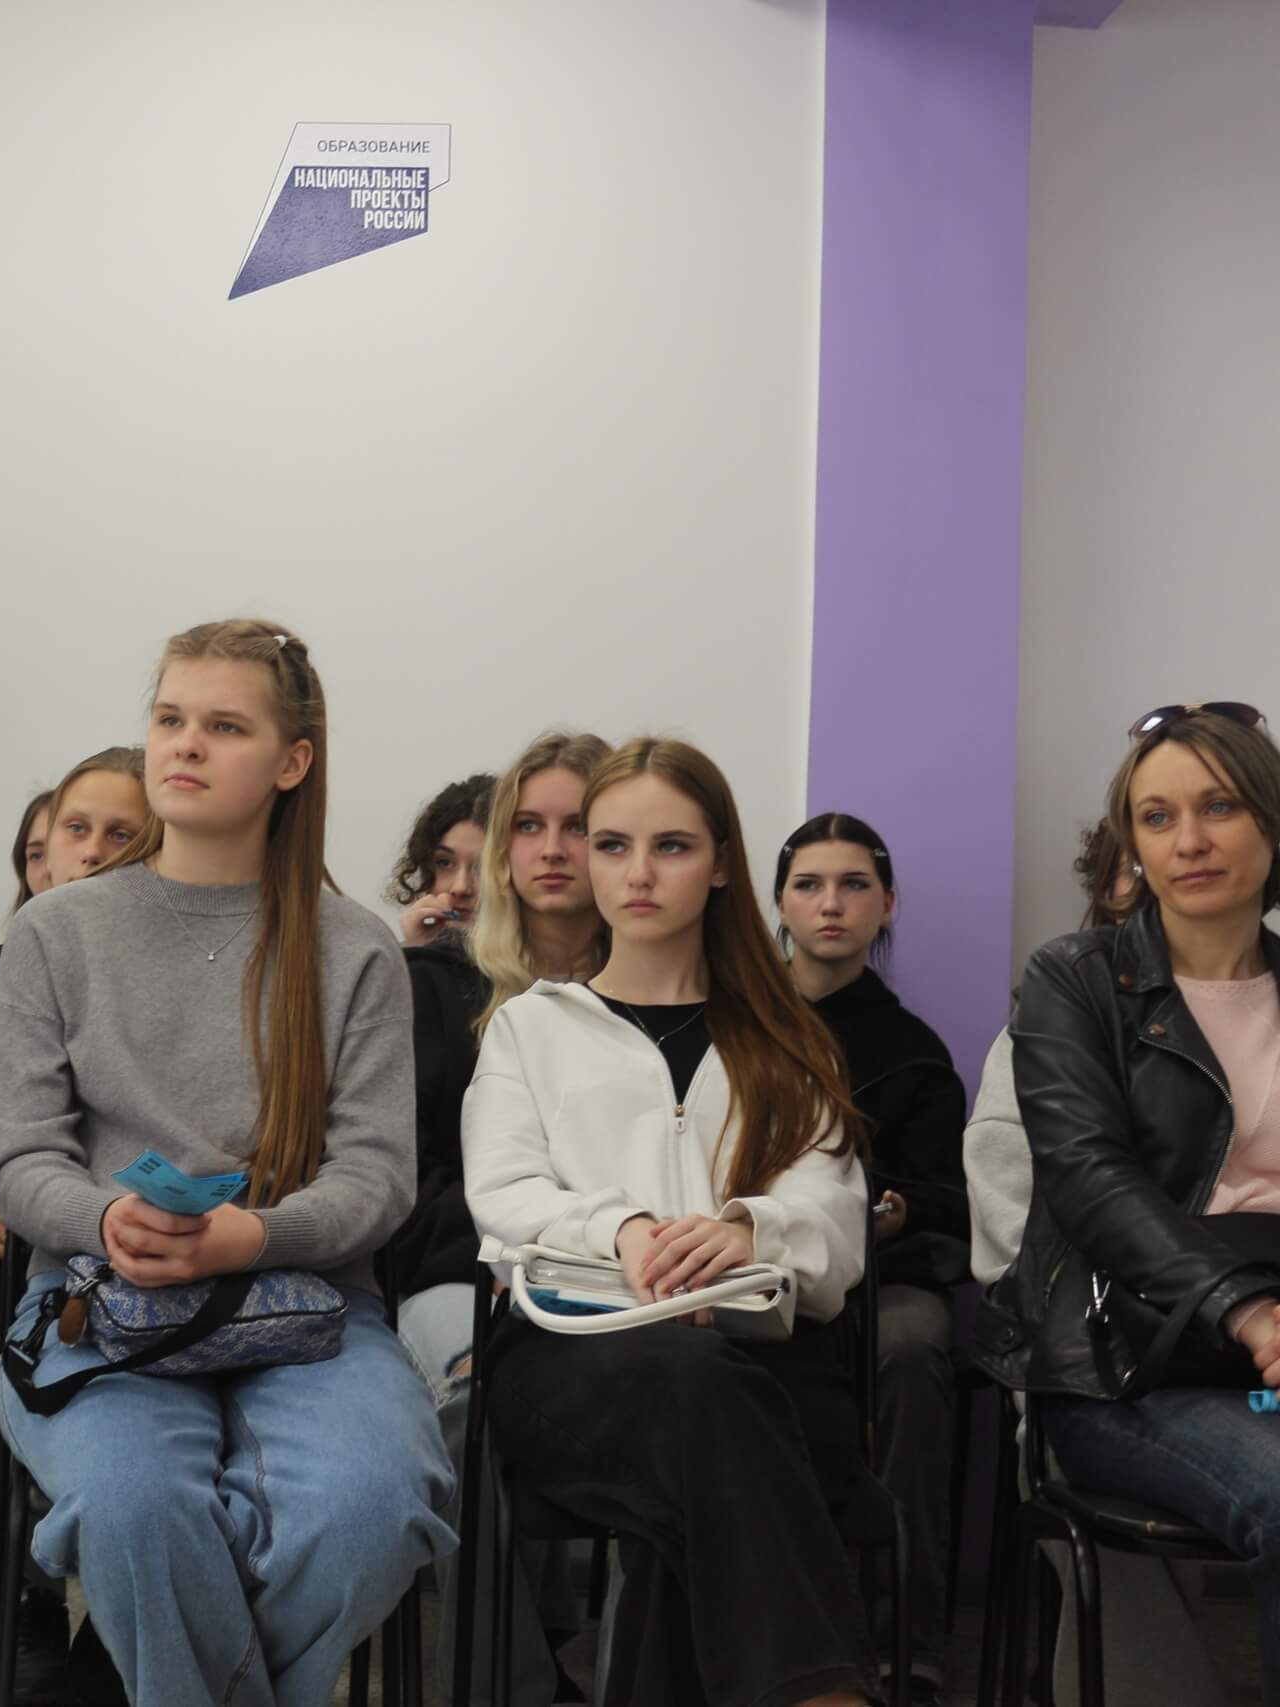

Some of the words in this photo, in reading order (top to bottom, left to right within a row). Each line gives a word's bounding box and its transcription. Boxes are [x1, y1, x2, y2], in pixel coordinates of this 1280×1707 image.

[317, 140, 431, 153] ОБРАЗОВАНИЕ
[294, 168, 426, 189] НАЦИОНАЛЬНЫЕ
[350, 190, 426, 209] ПРОЕКТЫ
[363, 210, 425, 229] РОССИИ
